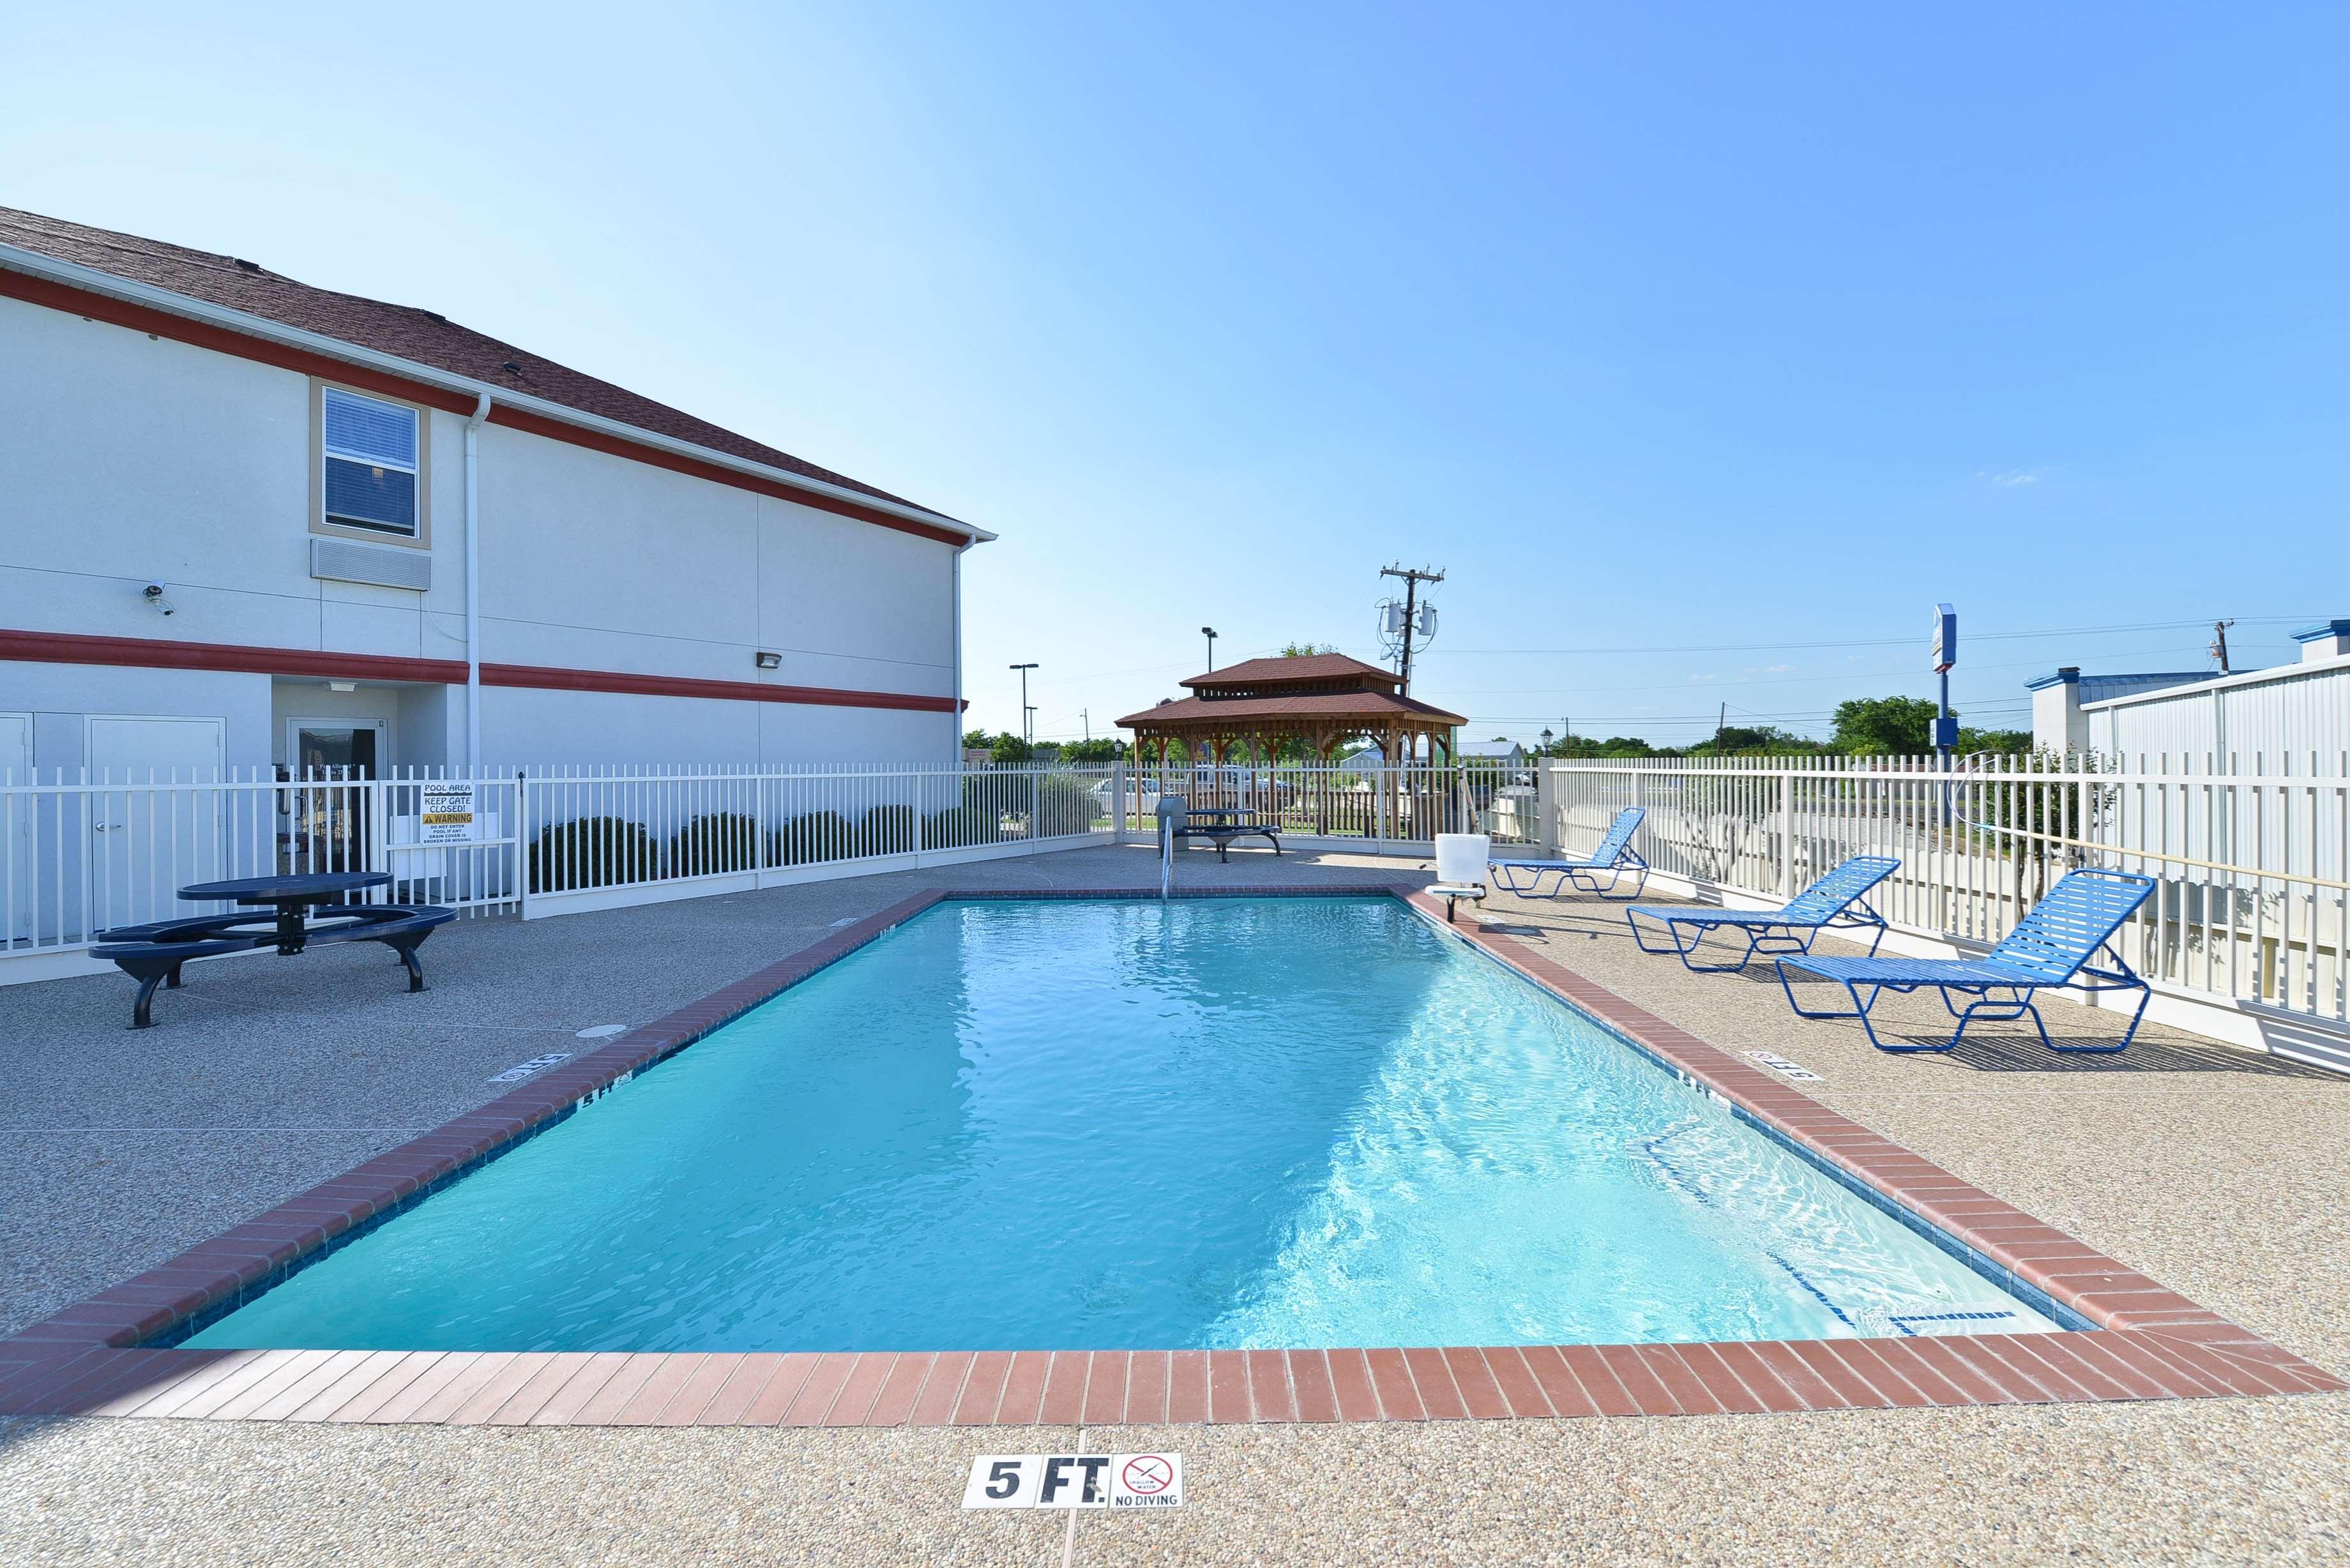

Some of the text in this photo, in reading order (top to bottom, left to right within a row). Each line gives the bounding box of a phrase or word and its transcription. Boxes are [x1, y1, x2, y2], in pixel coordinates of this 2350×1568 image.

[435, 814, 472, 823] WARNING
[582, 1092, 594, 1108] 5
[985, 1461, 1020, 1499] 5
[1116, 1495, 1178, 1506] NO DIVING
